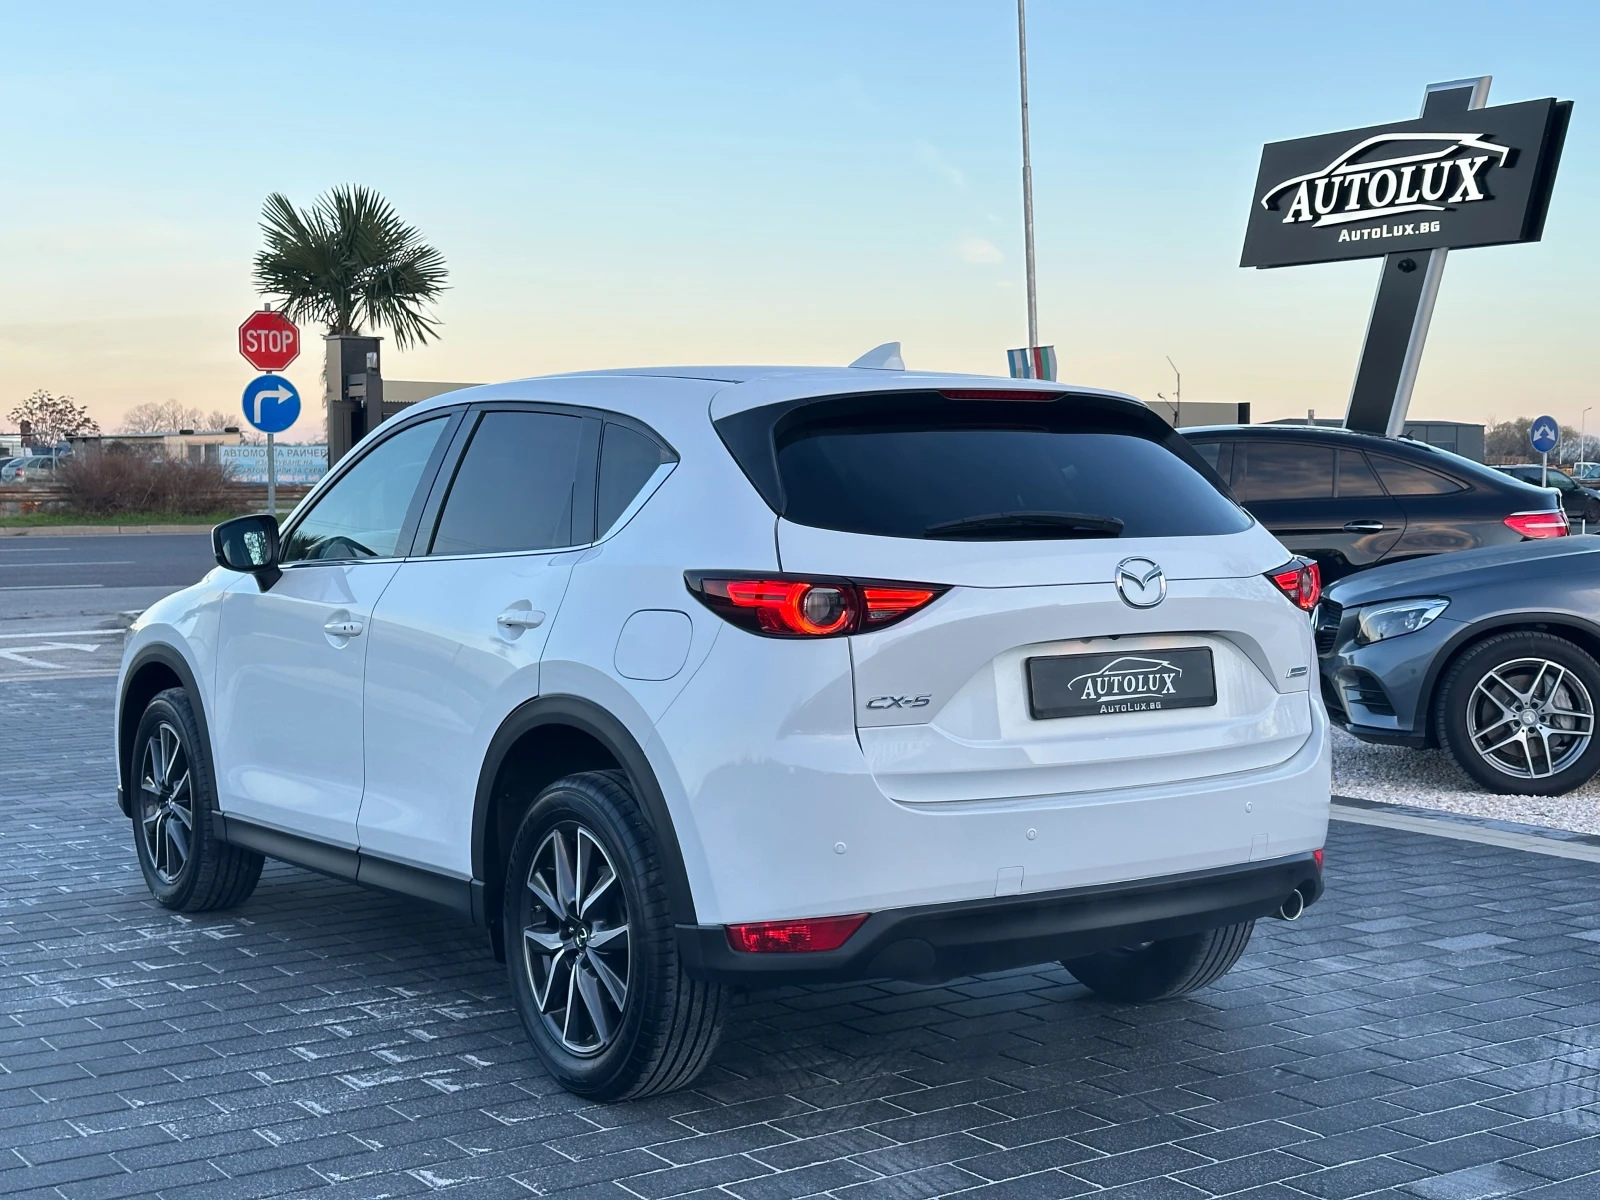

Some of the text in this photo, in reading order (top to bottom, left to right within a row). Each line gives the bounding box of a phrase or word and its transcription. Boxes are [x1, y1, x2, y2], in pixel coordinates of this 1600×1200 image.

[1282, 156, 1488, 224] AUTOLUX
[246, 329, 294, 353] STOP
[1080, 672, 1176, 701] AUTOLUX
[865, 693, 932, 711] CX-5
